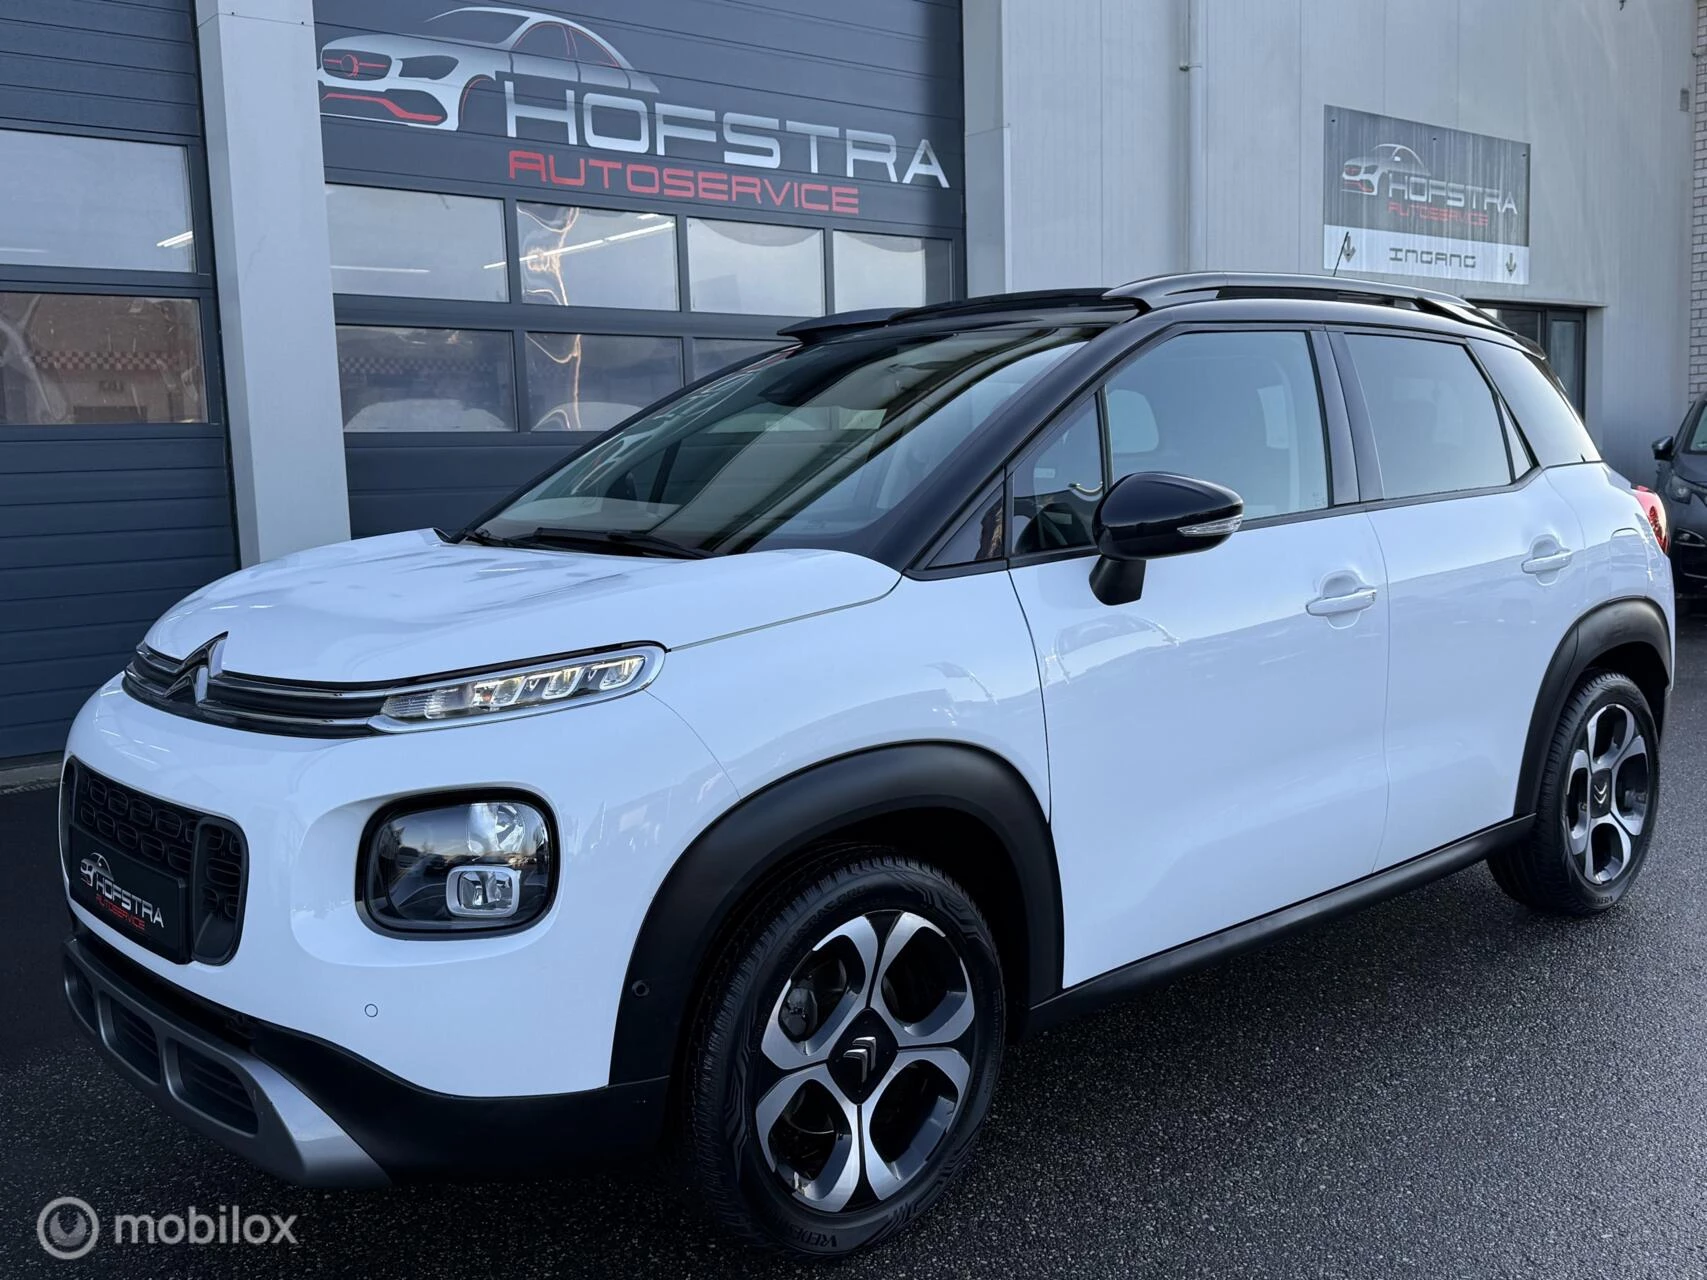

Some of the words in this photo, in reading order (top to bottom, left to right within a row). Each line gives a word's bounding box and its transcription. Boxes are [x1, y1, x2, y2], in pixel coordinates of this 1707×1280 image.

[504, 81, 950, 188] HOFSTRA
[509, 151, 859, 214] AUTOSERVICE
[1389, 173, 1518, 214] HOFSTRA
[1387, 202, 1489, 227] AUTOSERVICE
[1389, 247, 1477, 269] INGANG
[96, 872, 165, 929] HOFSTRA
